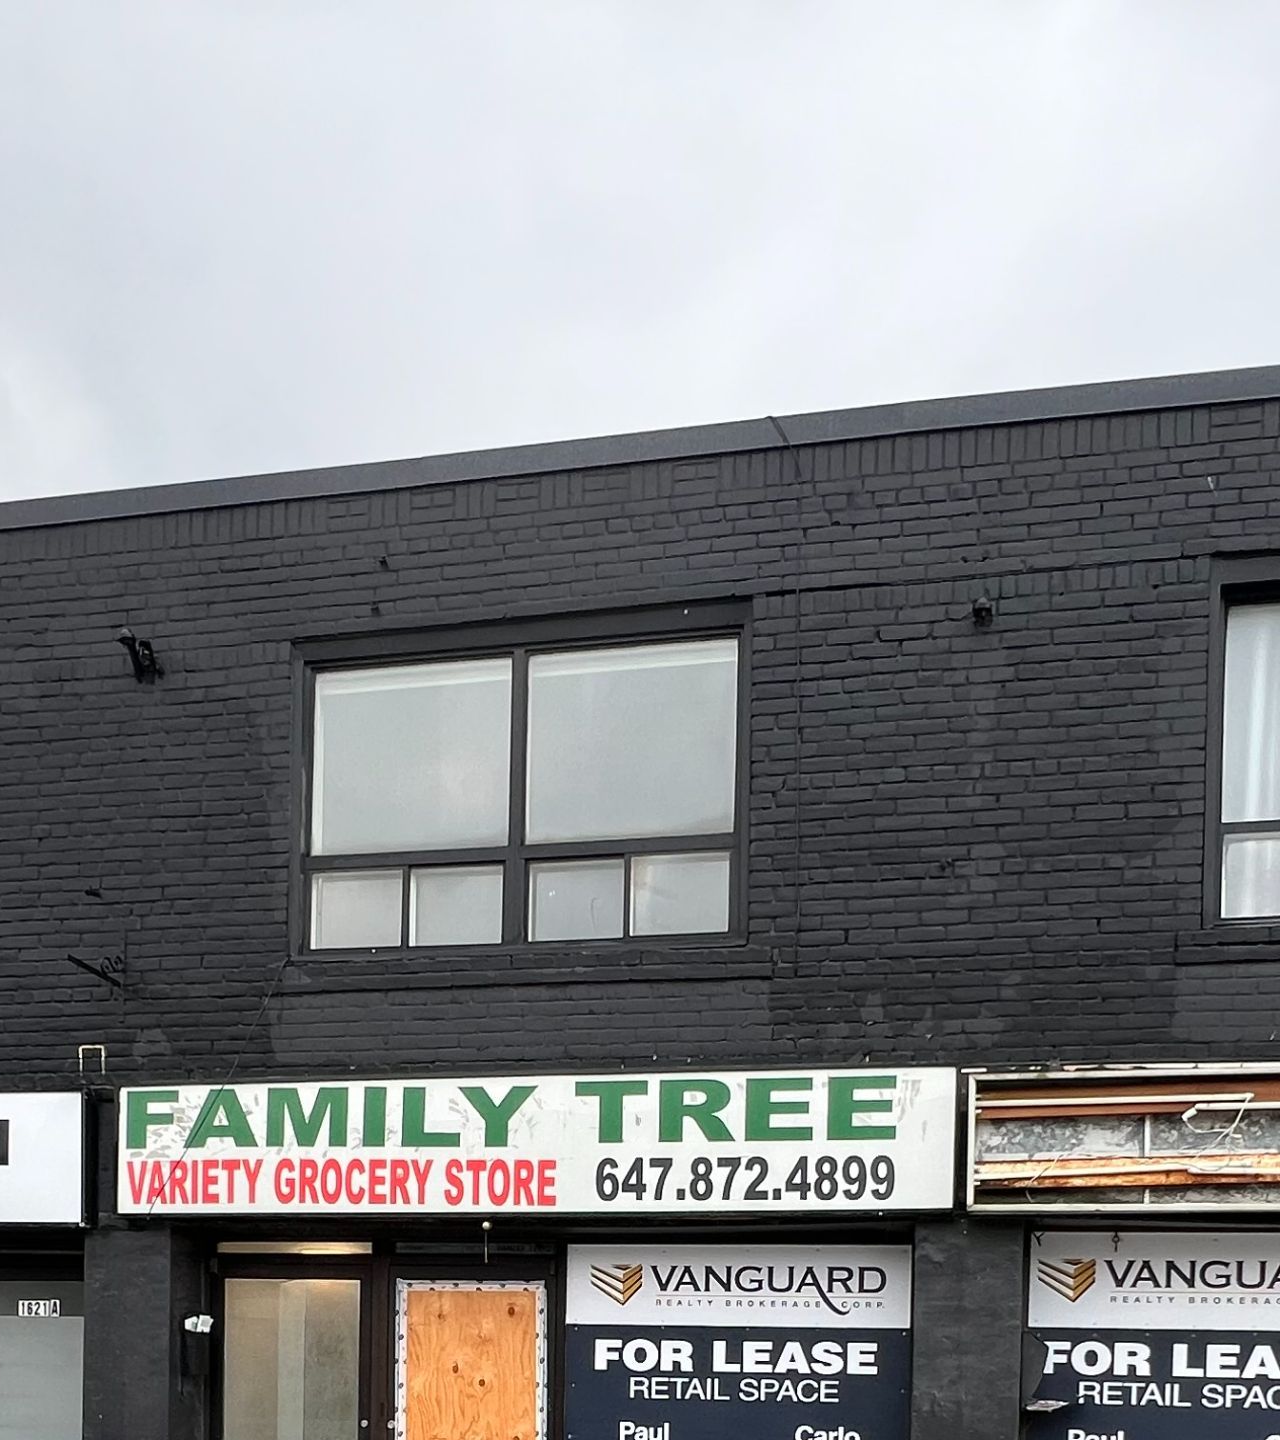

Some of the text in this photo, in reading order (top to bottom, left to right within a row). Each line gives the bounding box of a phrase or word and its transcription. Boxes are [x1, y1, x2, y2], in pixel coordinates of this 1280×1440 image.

[125, 1074, 898, 1149] FAMILY TREE
[126, 1158, 557, 1206] VARIETY GROCERY STORE
[595, 1155, 896, 1202] 647.872.4899
[650, 1264, 888, 1315] VANGUARD
[725, 1300, 821, 1308] BROKERAGE
[1110, 1295, 1176, 1304] REALTY
[594, 1338, 879, 1376] FOR LEASE
[1043, 1340, 1152, 1377] FOR
[629, 1376, 840, 1403] RETAIL SPACE
[1078, 1381, 1192, 1408] RETAIL
